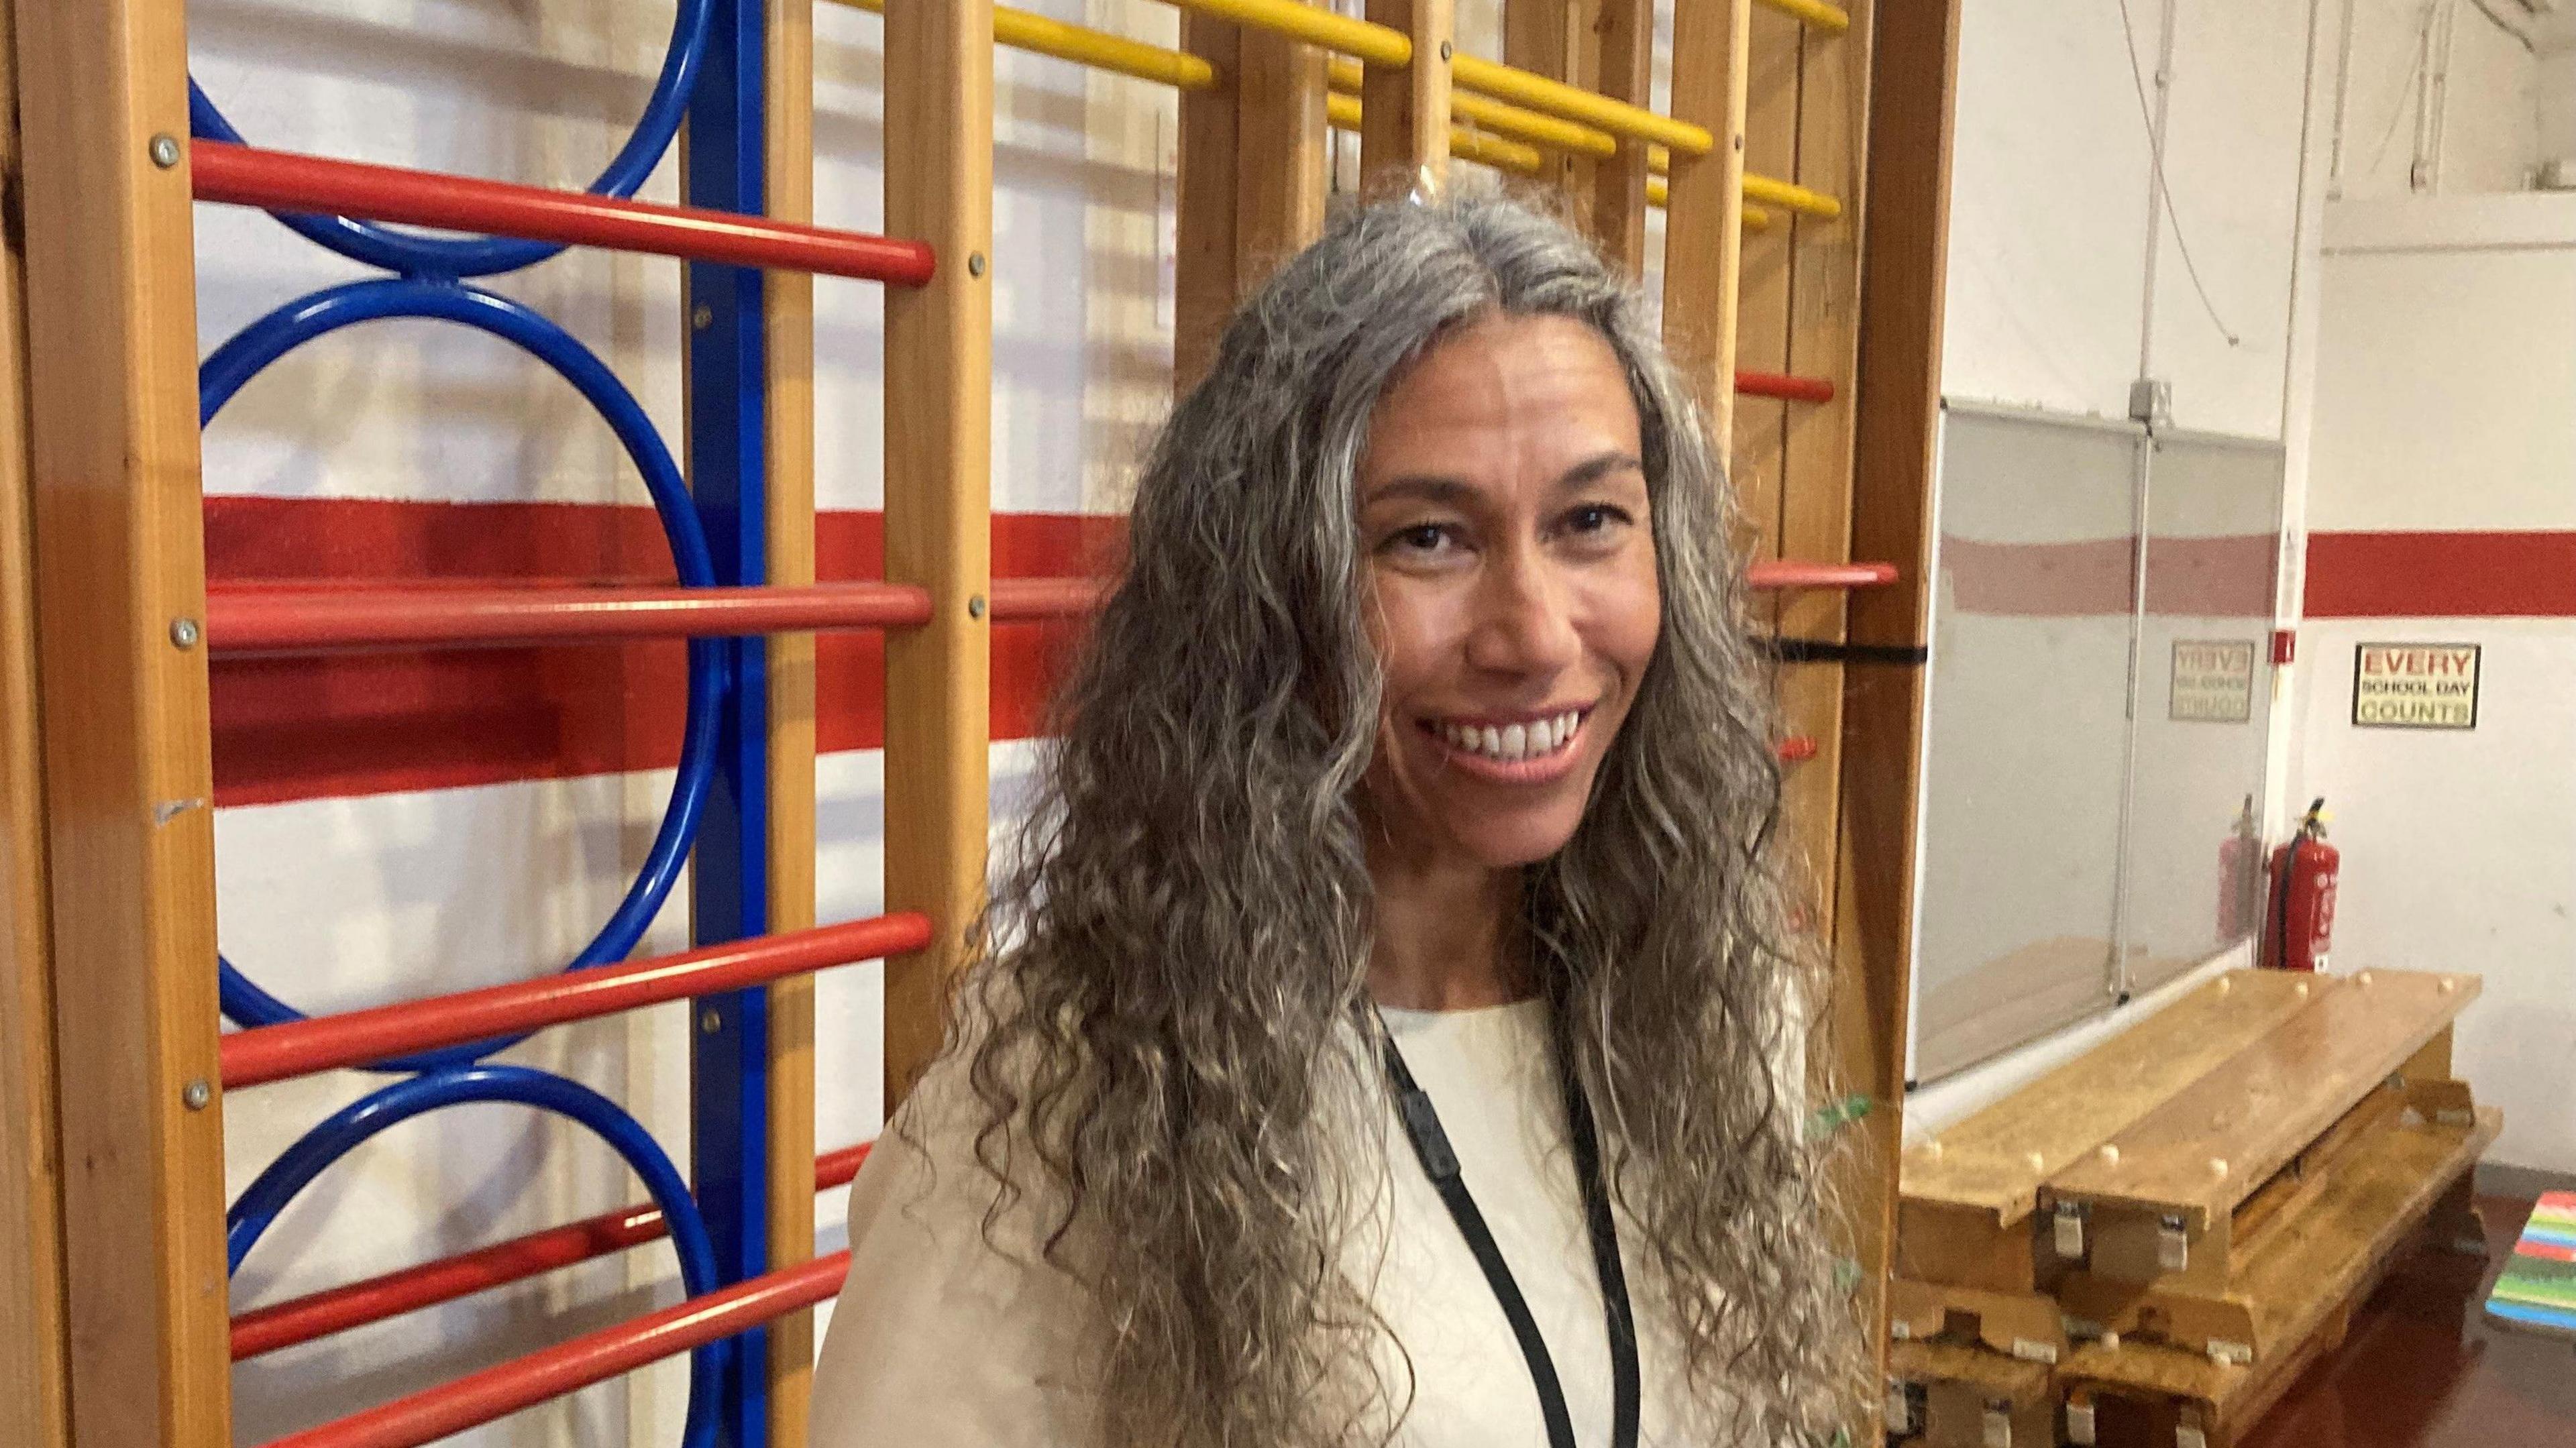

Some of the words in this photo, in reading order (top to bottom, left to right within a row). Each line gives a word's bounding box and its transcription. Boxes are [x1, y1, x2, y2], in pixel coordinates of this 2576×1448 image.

[2365, 650, 2471, 675] EVERY
[2363, 680, 2432, 695] SCHOOL
[2436, 680, 2470, 696] DAY
[2361, 700, 2469, 724] COUNTS
